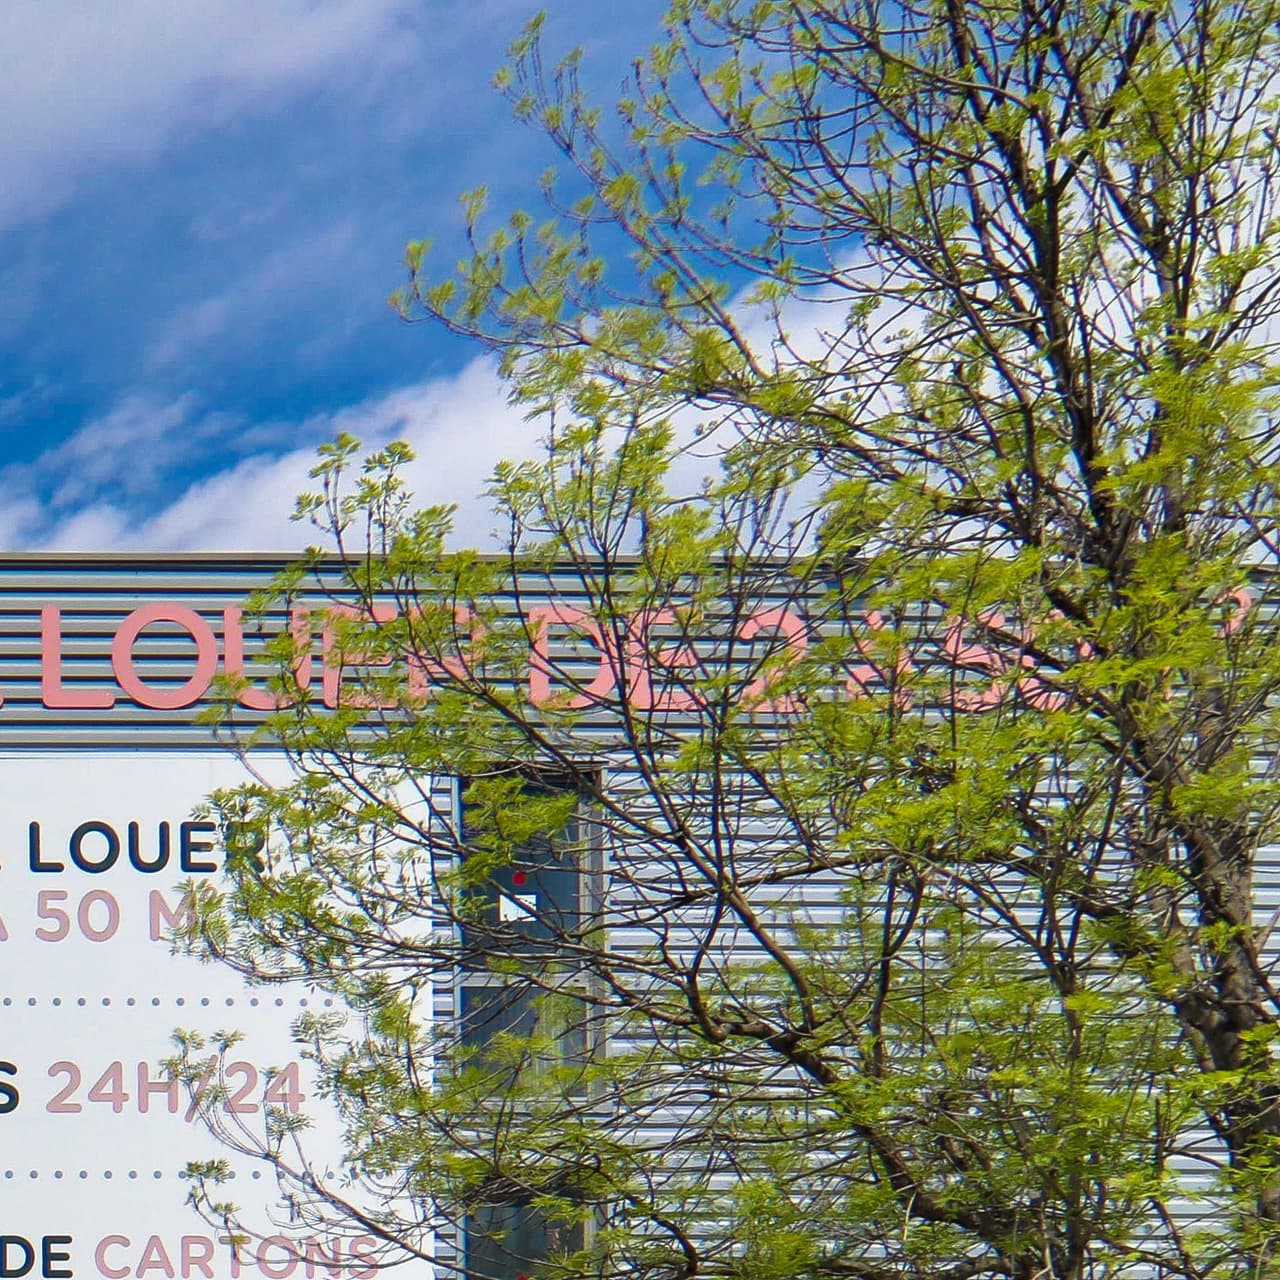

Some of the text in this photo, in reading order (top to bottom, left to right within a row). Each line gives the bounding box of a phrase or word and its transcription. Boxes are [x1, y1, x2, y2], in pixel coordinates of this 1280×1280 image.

[28, 819, 266, 875] LOUER
[35, 889, 120, 943] 50
[46, 1054, 306, 1123] 24H/24
[94, 1234, 380, 1280] CARTONS
